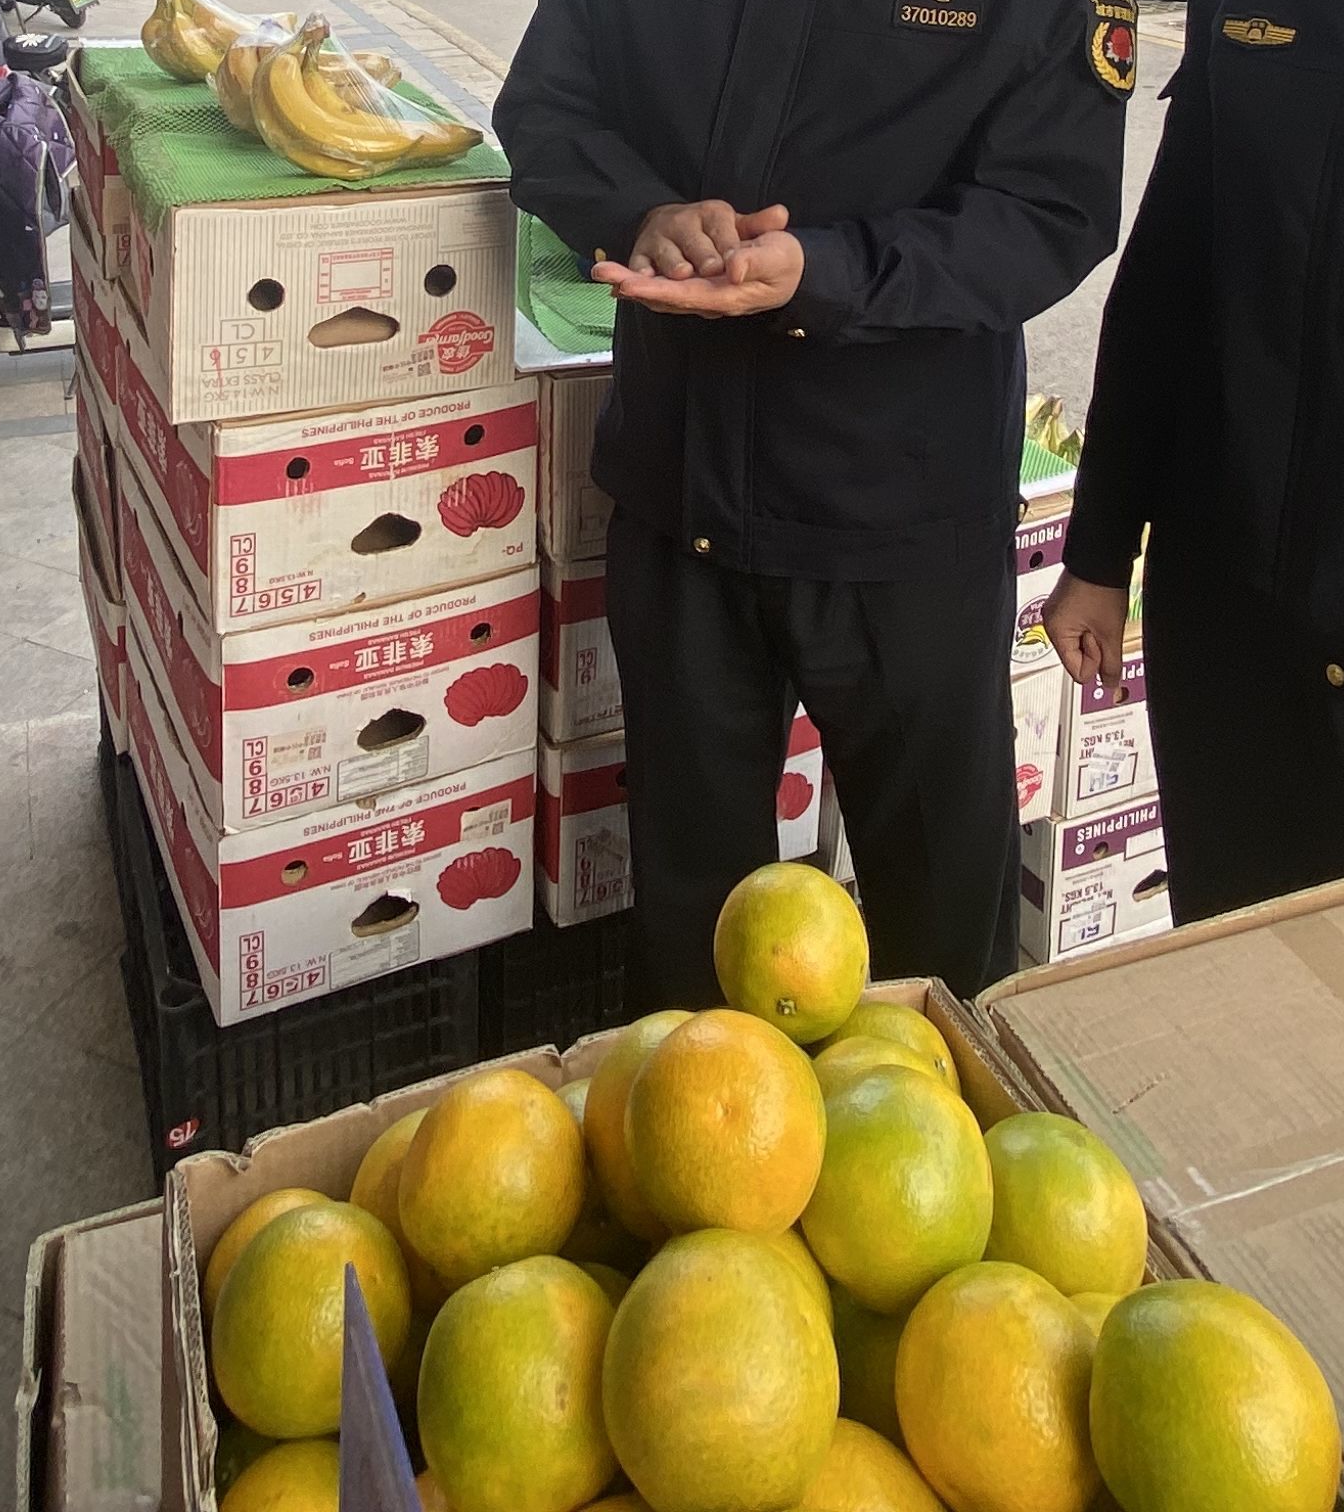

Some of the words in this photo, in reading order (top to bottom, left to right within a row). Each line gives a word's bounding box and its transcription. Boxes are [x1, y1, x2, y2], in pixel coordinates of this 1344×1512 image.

[901, 5, 977, 28] 37010289
[232, 323, 255, 340] CL
[236, 348, 249, 364] 5
[262, 347, 274, 361] 4
[243, 371, 281, 385] CLASS
[401, 410, 416, 422] OF
[419, 400, 471, 418] PRODUCE
[301, 418, 373, 439] PHILIPPINES
[375, 415, 396, 427] THE
[359, 434, 440, 471] 索菲亚
[232, 537, 253, 554] CL
[236, 558, 248, 574] 9
[236, 578, 249, 594] 8
[235, 597, 248, 613] 7
[258, 593, 271, 609] 6
[281, 588, 294, 604] 5
[303, 584, 316, 600] 4
[425, 595, 477, 614] PRODUCE
[383, 614, 404, 624] THE
[407, 608, 422, 621] OF
[308, 619, 379, 642] PHILIPPINES
[353, 632, 434, 672] 索菲亚
[246, 740, 264, 756] CL
[249, 760, 262, 776] 9
[249, 779, 262, 795] 8
[416, 782, 467, 804] PRODUCE
[248, 798, 262, 815] 7
[270, 791, 283, 808] 6
[311, 782, 325, 797] 4
[399, 799, 413, 810] OF
[373, 804, 396, 816] THE
[303, 810, 372, 837] PHILIPPINES
[1077, 805, 1157, 842] PHILIPPINES
[347, 819, 426, 864] 索菲亚
[243, 936, 260, 951] CL
[246, 954, 259, 970] 9
[246, 972, 259, 988] 8
[246, 990, 259, 1006] 7
[267, 985, 280, 999] 6
[307, 971, 320, 986] 4
